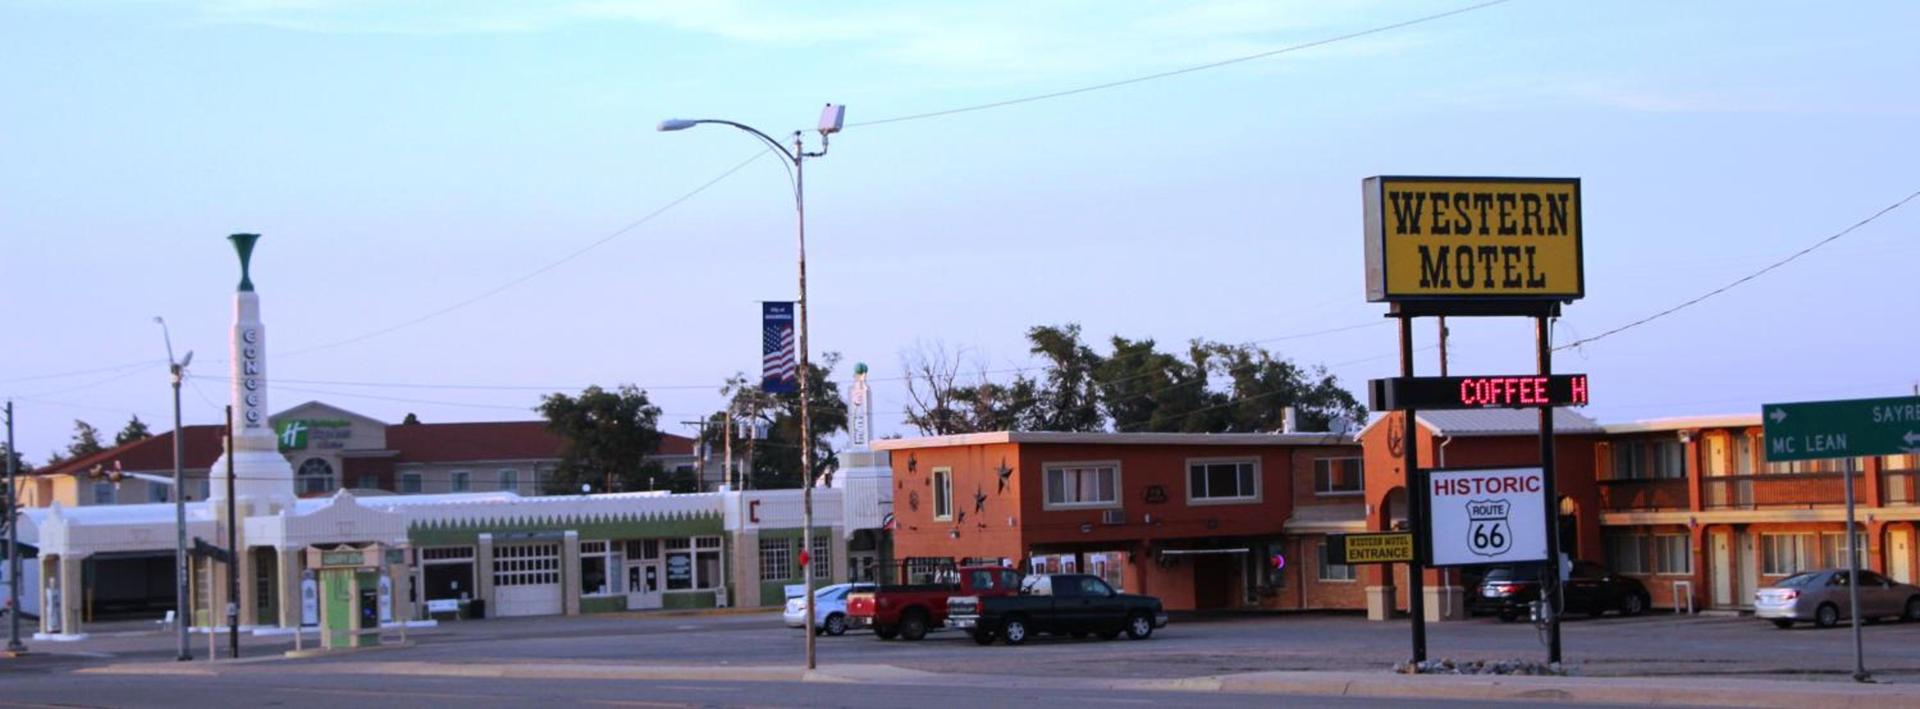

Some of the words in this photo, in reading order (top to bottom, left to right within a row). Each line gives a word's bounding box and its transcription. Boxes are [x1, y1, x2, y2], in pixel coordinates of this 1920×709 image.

[1389, 191, 1569, 236] WESTERN
[1418, 245, 1546, 289] MOTEL
[243, 328, 259, 422] CONOCO
[1461, 378, 1549, 404] COFFEE
[1571, 376, 1587, 403] H
[1772, 435, 1795, 453] MC
[1805, 432, 1847, 452] LEAN
[1434, 475, 1541, 496] HISTORIC
[1472, 504, 1505, 516] ROUTE
[1474, 522, 1505, 549] 66
[1349, 546, 1409, 560] ENTRANCE
